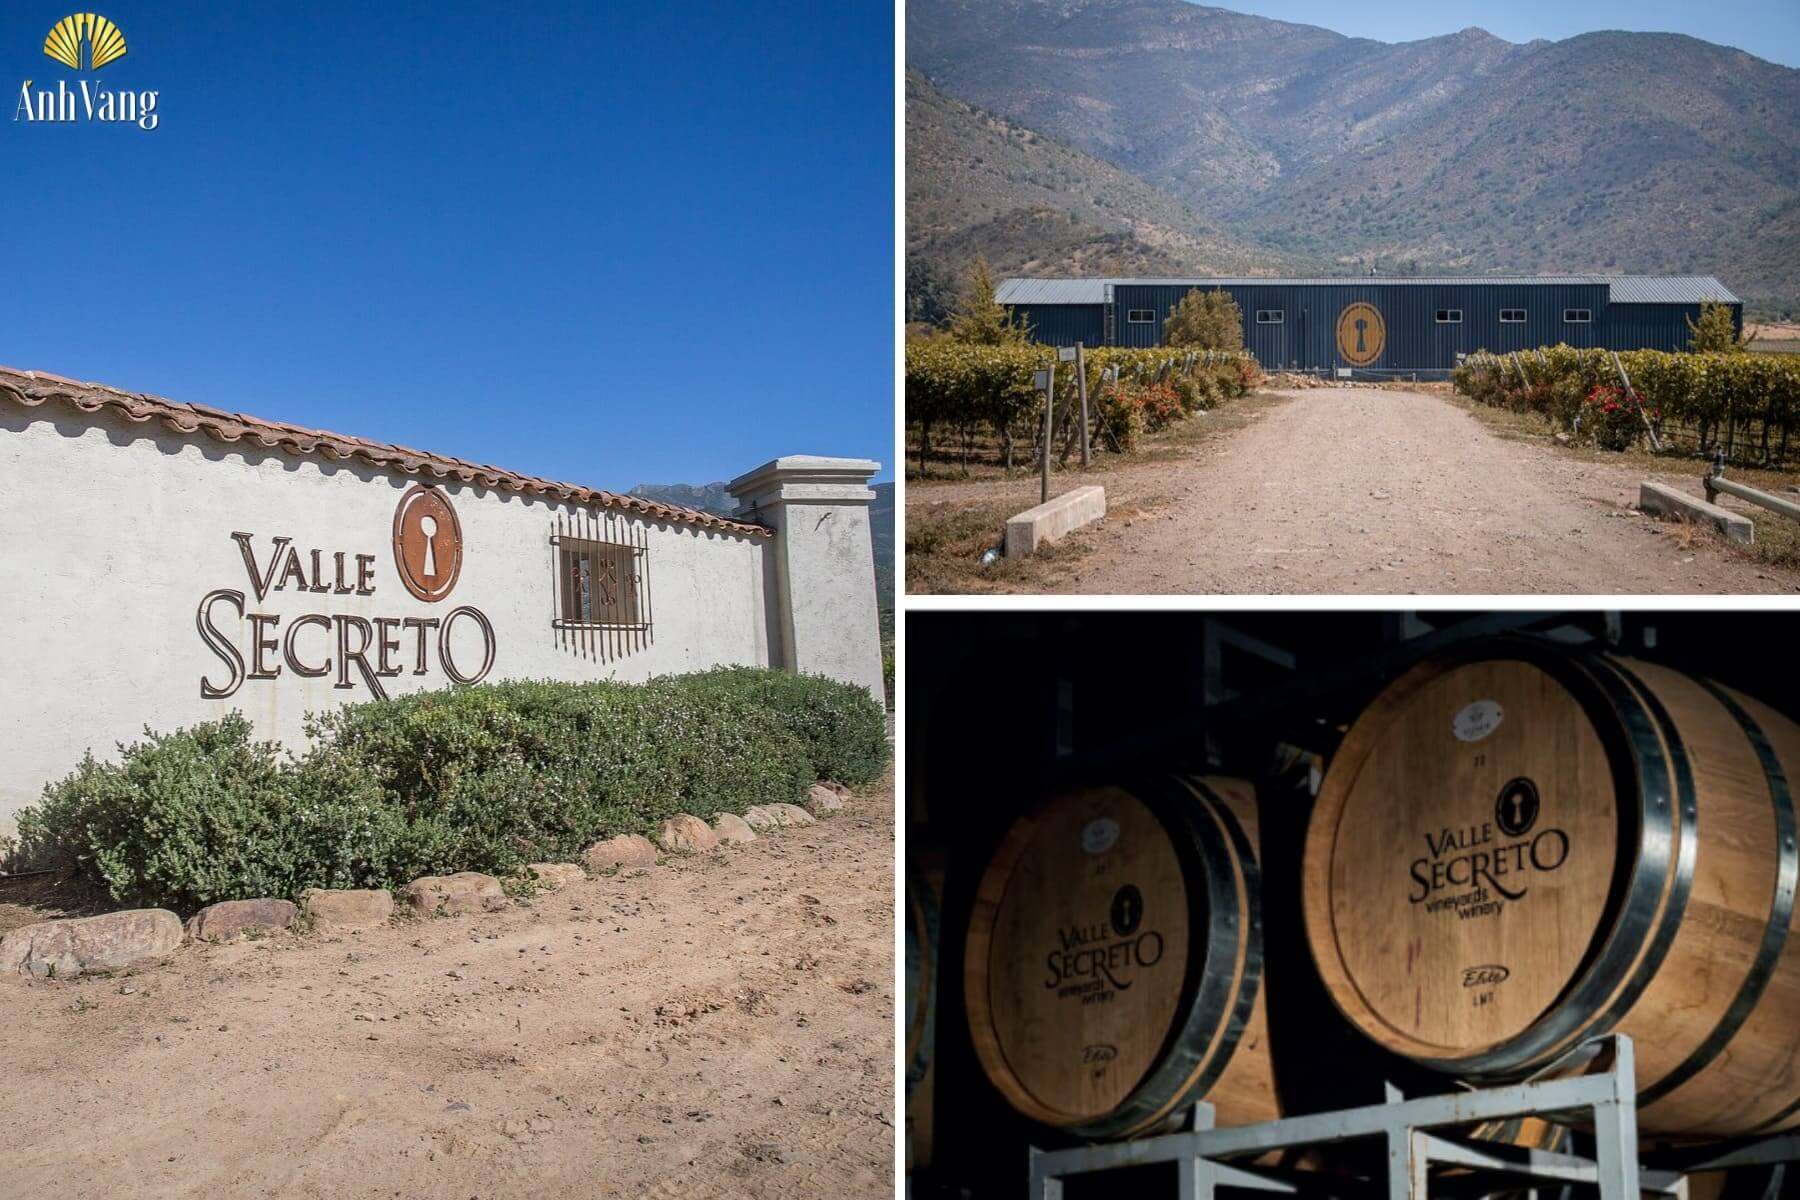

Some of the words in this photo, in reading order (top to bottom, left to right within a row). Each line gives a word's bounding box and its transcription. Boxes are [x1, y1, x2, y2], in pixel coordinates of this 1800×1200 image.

[230, 531, 377, 604] VALLE
[196, 588, 497, 701] SECRETO
[1408, 828, 1570, 904] SECRETO
[1424, 822, 1493, 860] VALLE
[1457, 900, 1504, 920] winery
[1045, 930, 1164, 990] SECRETO
